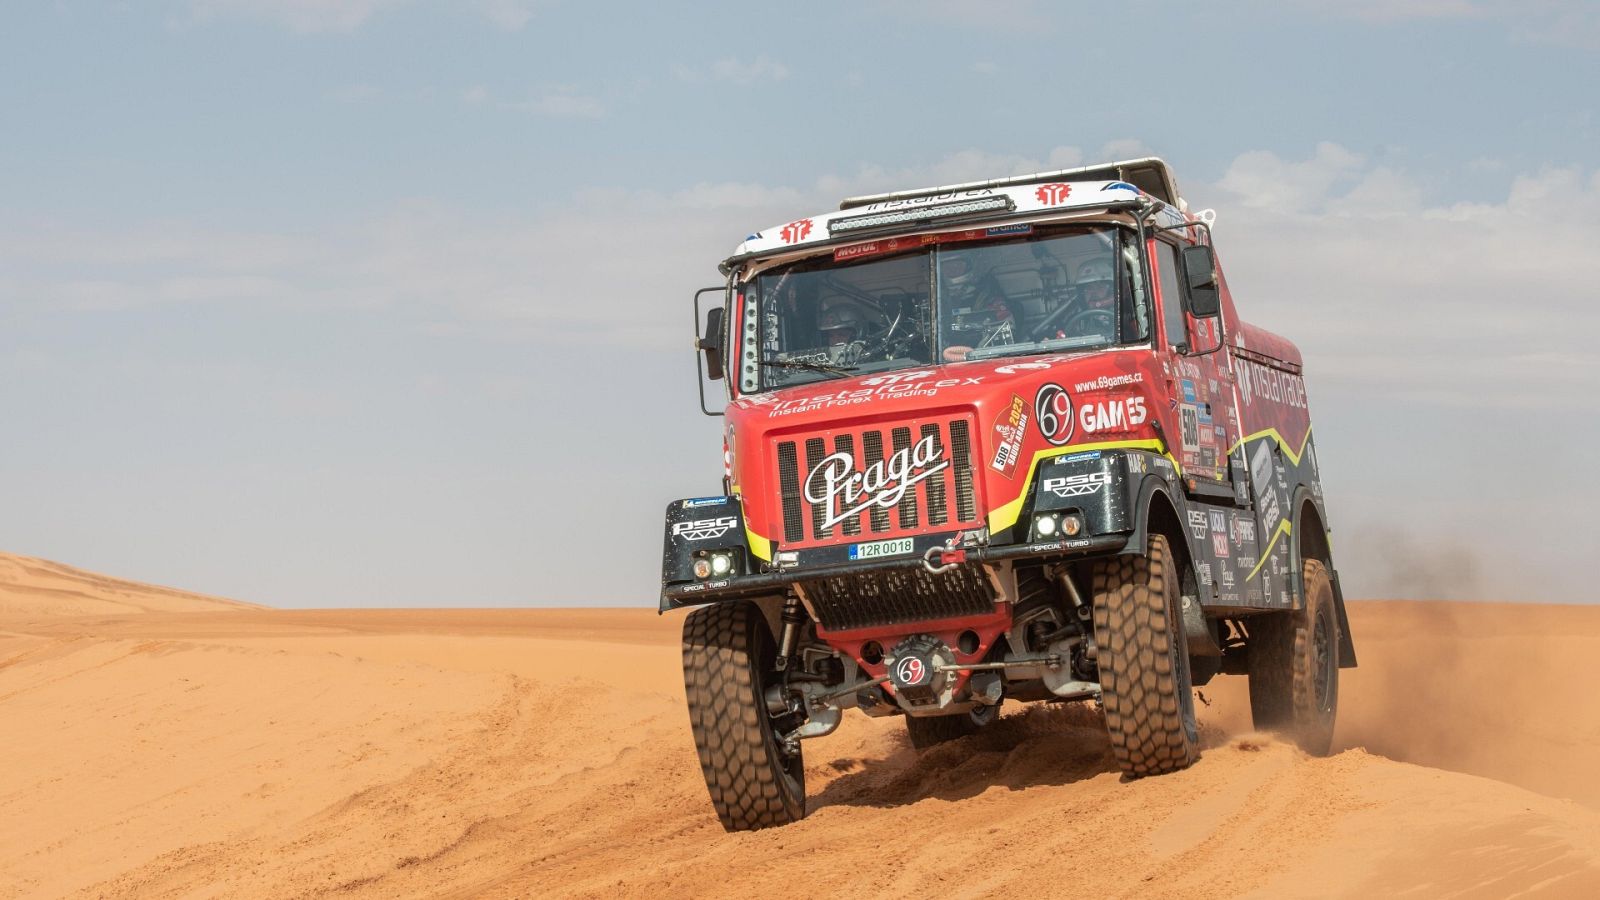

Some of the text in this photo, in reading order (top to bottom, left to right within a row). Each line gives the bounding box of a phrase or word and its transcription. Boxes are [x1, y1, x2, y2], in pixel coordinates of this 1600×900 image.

[838, 243, 876, 257] MOTUL
[1075, 372, 1144, 393] www.69games.cz
[768, 387, 938, 418] Instant Forex Trading
[1008, 396, 1024, 427] 2023
[1039, 388, 1073, 440] 69
[1080, 396, 1147, 433] GAMES
[1007, 413, 1028, 466] SAUDI ARABIA
[1182, 408, 1198, 446] 508
[996, 446, 1009, 466] 508
[804, 434, 948, 531] Praga
[860, 540, 912, 557] 12R 0018
[1034, 540, 1089, 552] SPECIAL TURBO
[683, 580, 727, 593] SPECIAL TURBO
[899, 658, 923, 684] 69
